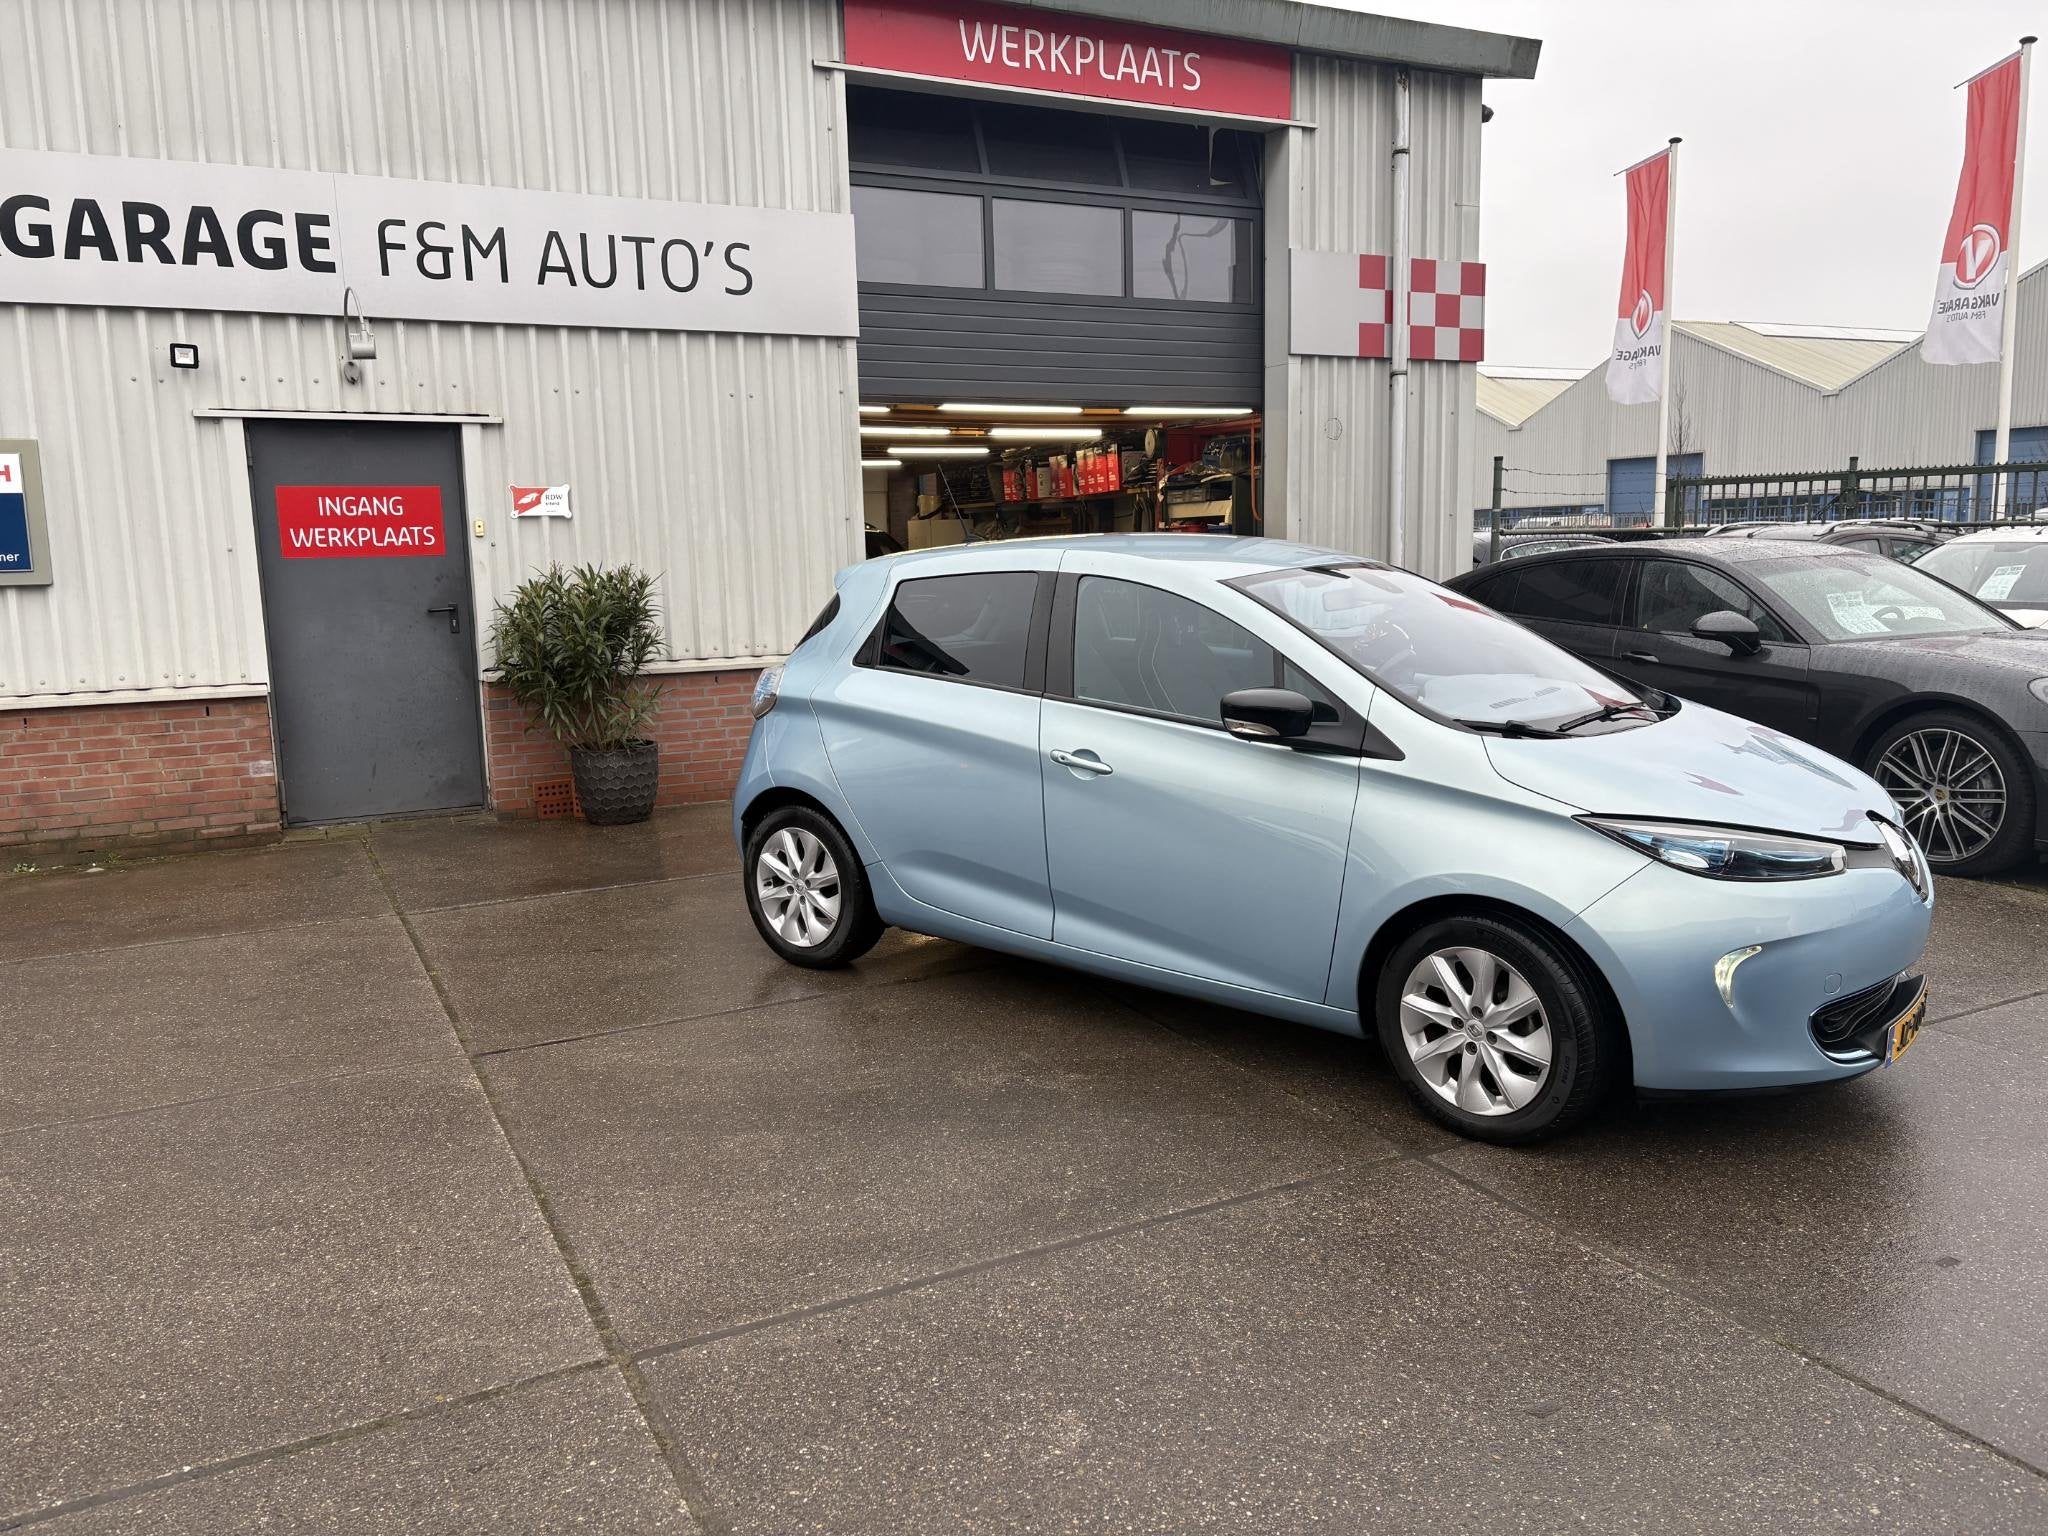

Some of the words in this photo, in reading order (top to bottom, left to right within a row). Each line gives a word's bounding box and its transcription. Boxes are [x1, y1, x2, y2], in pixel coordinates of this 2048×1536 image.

[959, 19, 1201, 91] WERKPLAATS
[377, 218, 510, 283] F&M
[537, 230, 754, 297] AUTO'S
[318, 496, 404, 516] INGANG
[289, 526, 436, 547] WERKPLAATS
